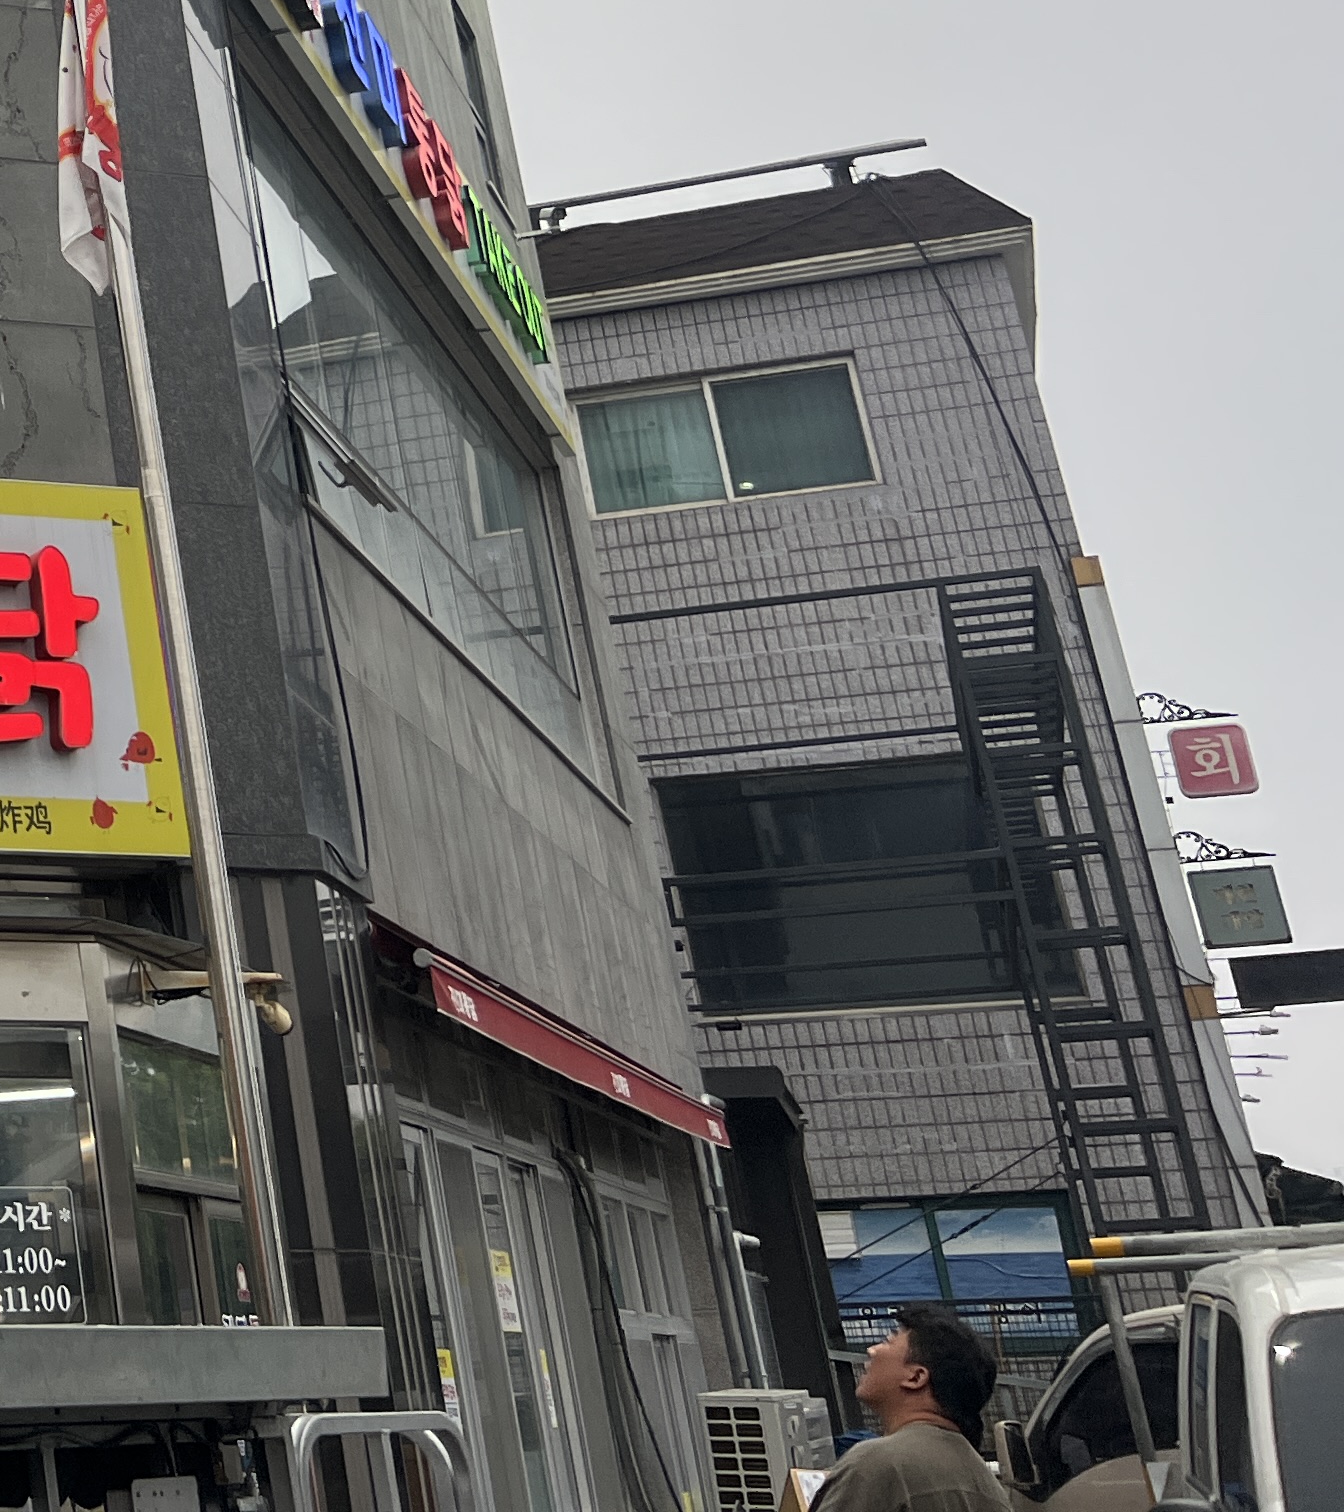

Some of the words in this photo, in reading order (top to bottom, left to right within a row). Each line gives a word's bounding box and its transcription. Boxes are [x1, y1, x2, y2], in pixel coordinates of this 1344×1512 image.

[464, 185, 521, 316] TAKE
[513, 264, 545, 351] OUT
[1189, 732, 1242, 786] 회
